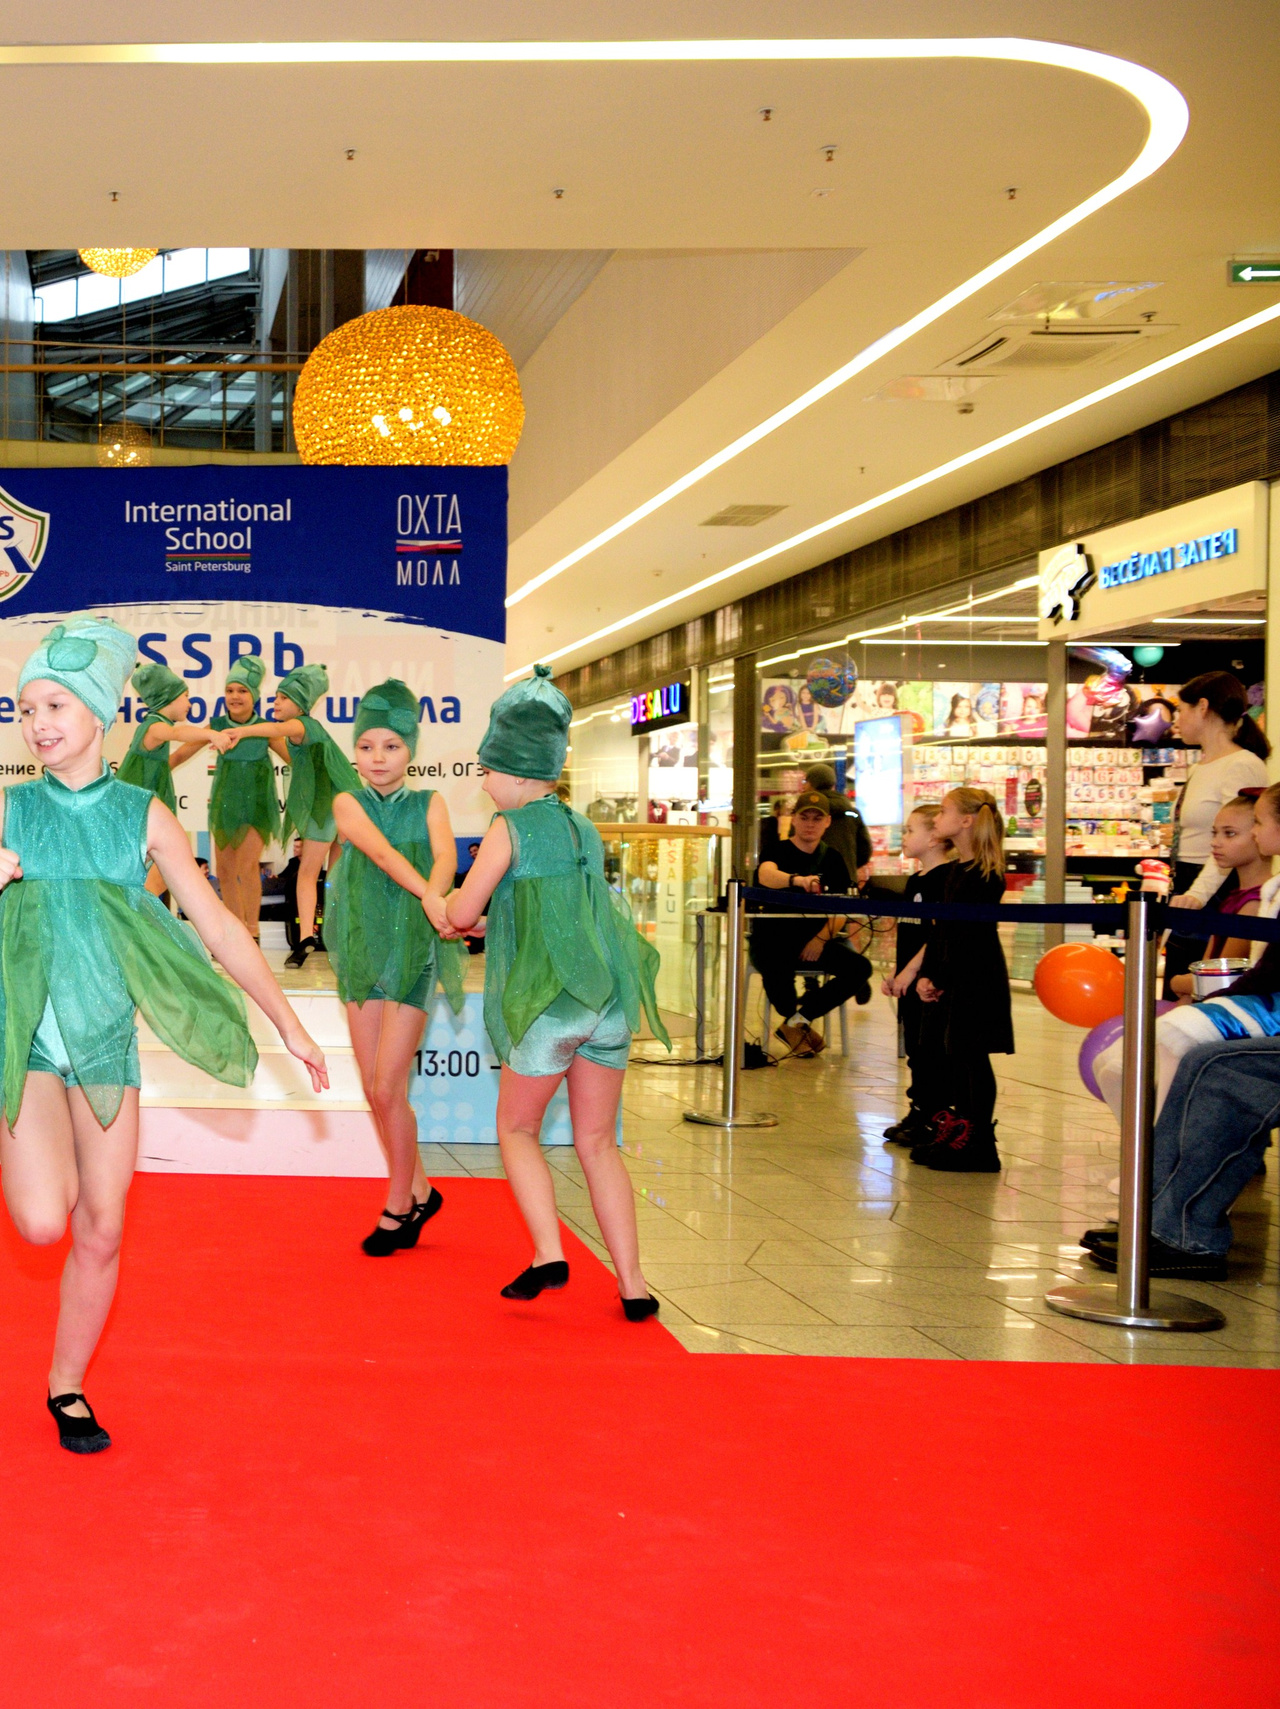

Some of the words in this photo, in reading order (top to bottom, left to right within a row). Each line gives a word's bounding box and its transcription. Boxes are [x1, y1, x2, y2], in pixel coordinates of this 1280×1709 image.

[125, 498, 292, 523] International
[396, 494, 463, 536] ОХТА
[165, 527, 252, 550] School
[165, 560, 192, 572] Saint
[195, 560, 252, 573] Petersburg
[1098, 547, 1174, 590] ВЕСЁЛАЯ
[1175, 528, 1238, 569] ЗАТЕЯ
[326, 695, 462, 724] шла
[630, 682, 681, 726] DESALU
[414, 1050, 480, 1077] 13:00
